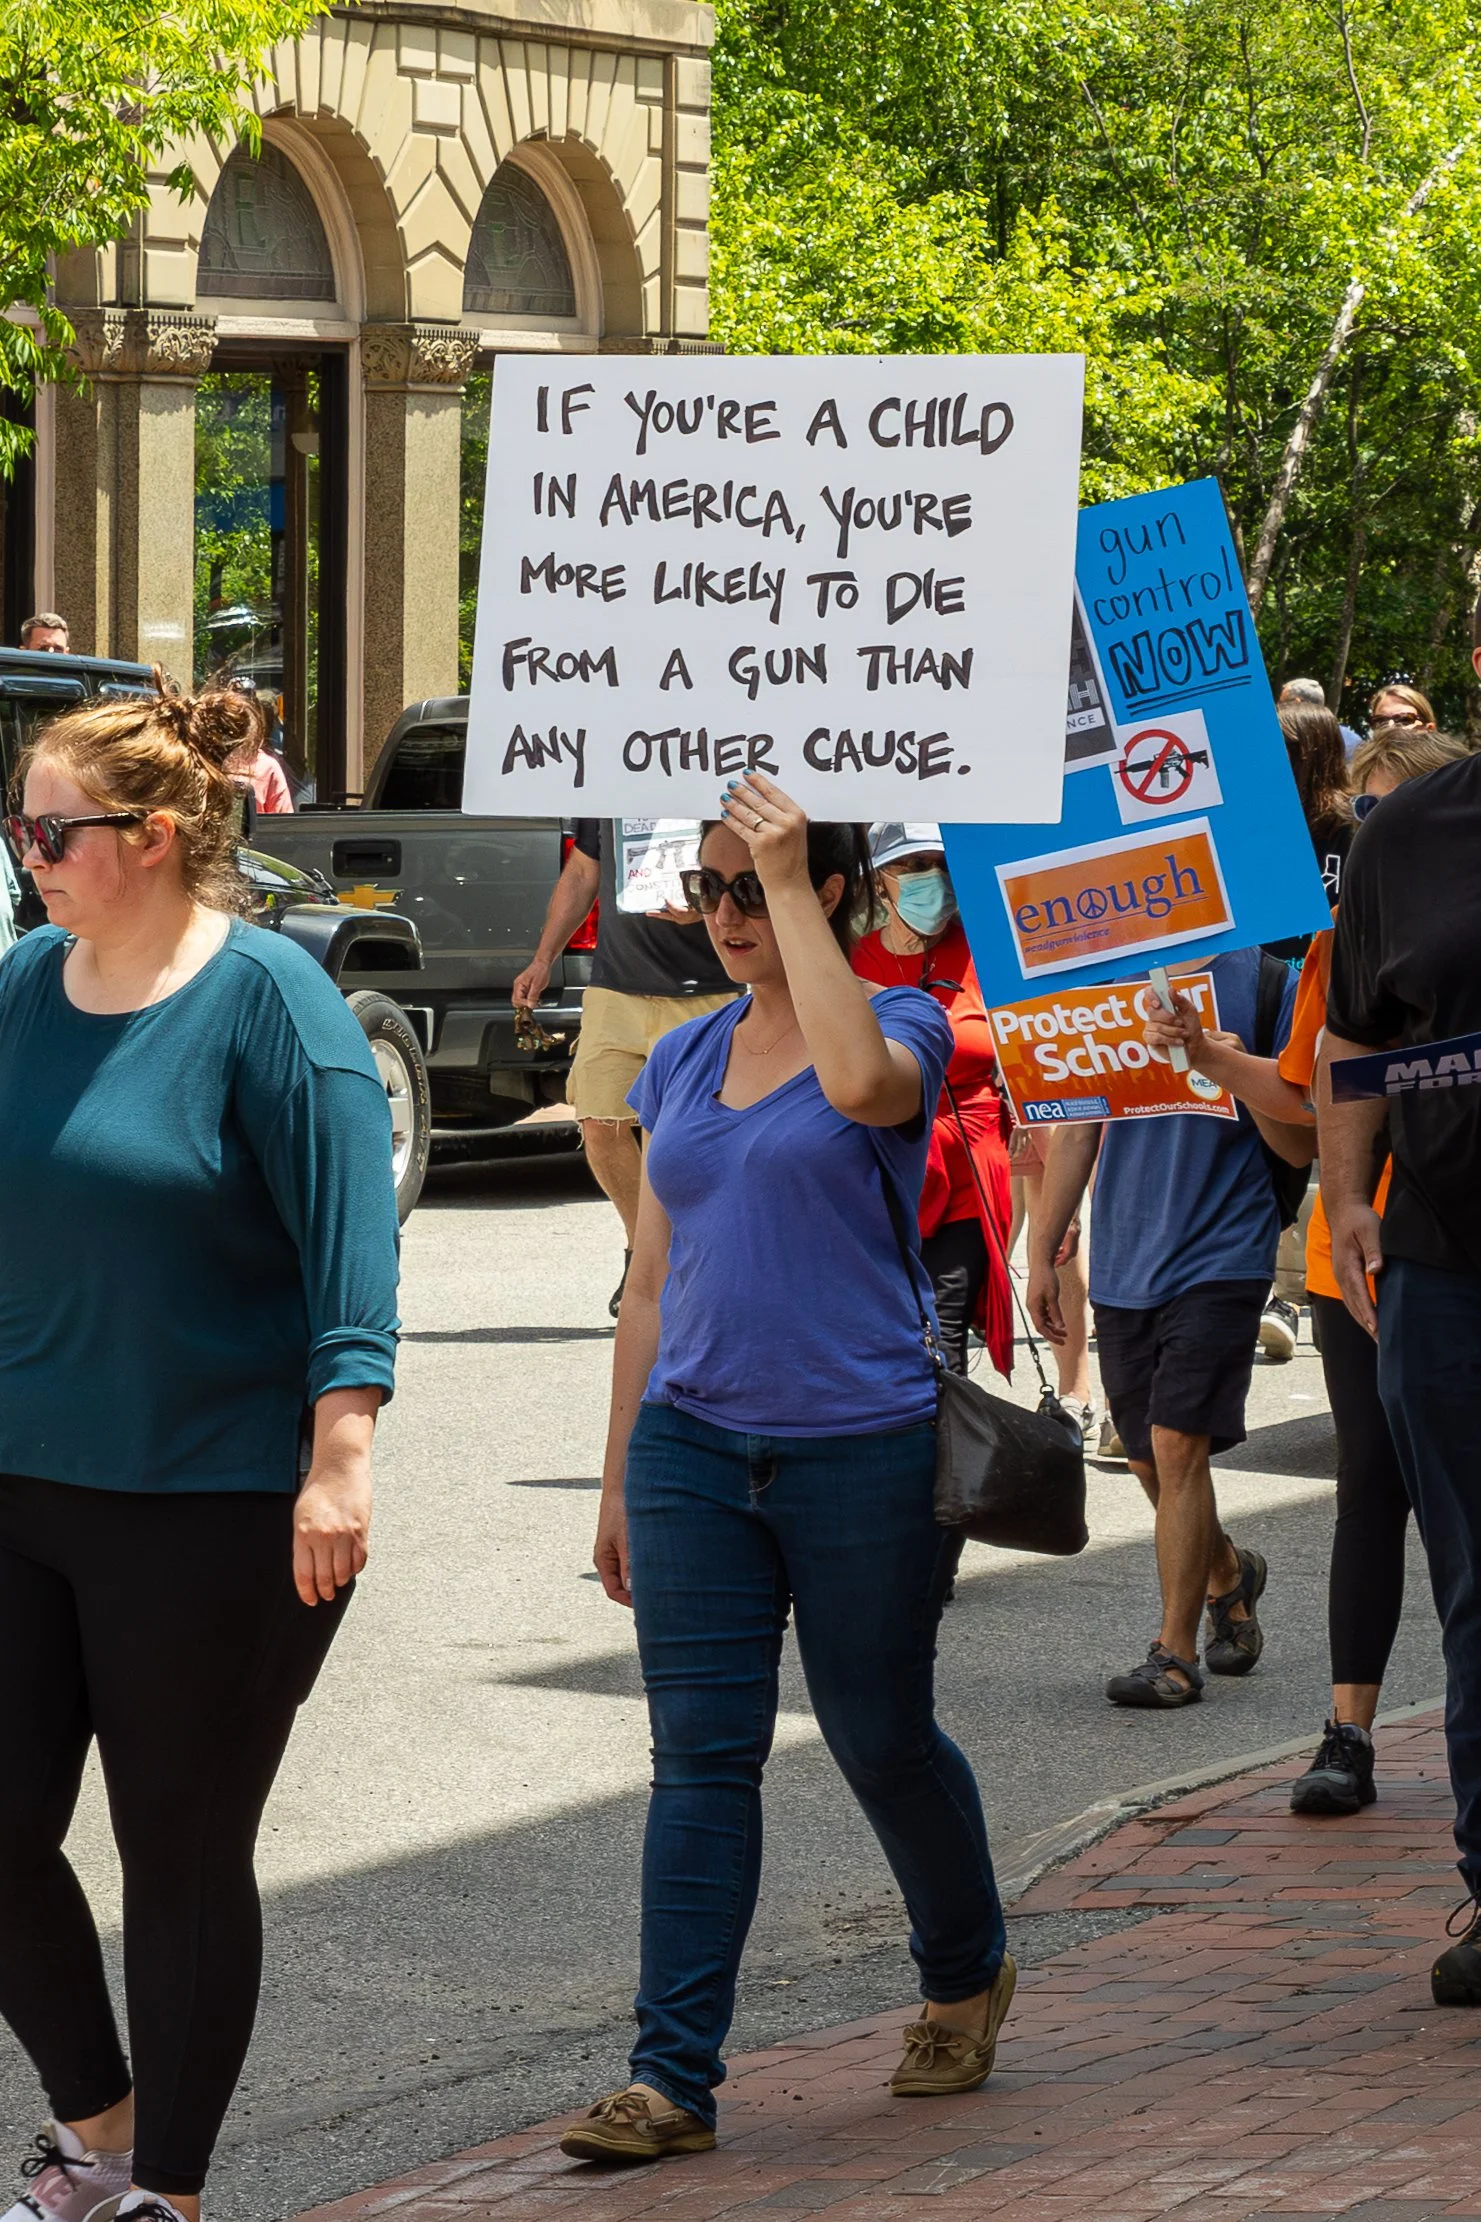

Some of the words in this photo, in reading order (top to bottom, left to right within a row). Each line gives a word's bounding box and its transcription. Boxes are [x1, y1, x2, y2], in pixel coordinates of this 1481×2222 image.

[537, 383, 596, 435] IF
[623, 389, 781, 456] YOU'RE
[805, 398, 848, 449] A
[868, 392, 1014, 456] CHILD
[533, 471, 577, 519] IN
[599, 472, 806, 544] AMERICA,
[819, 485, 972, 559] YOU'RE
[1099, 511, 1186, 586] gun
[520, 551, 627, 603] MORE
[653, 561, 786, 625] LIKELY
[806, 570, 859, 619] TO
[886, 567, 965, 626] DIE
[1094, 545, 1233, 626] control
[502, 637, 619, 692] FROM
[659, 647, 694, 691] A
[728, 643, 828, 701] GUN
[856, 645, 974, 691] THAN
[1108, 609, 1249, 699] NOW
[501, 724, 587, 788] ANY
[622, 727, 783, 777] OTHER
[802, 727, 971, 781] CAUSE.
[992, 995, 1134, 1045] Protect
[1033, 1033, 1173, 1082] Scho
[1385, 1049, 1481, 1083] MA
[1025, 1103, 1066, 1120] nea
[1123, 1101, 1230, 1114] ProtectOurSchools.com
